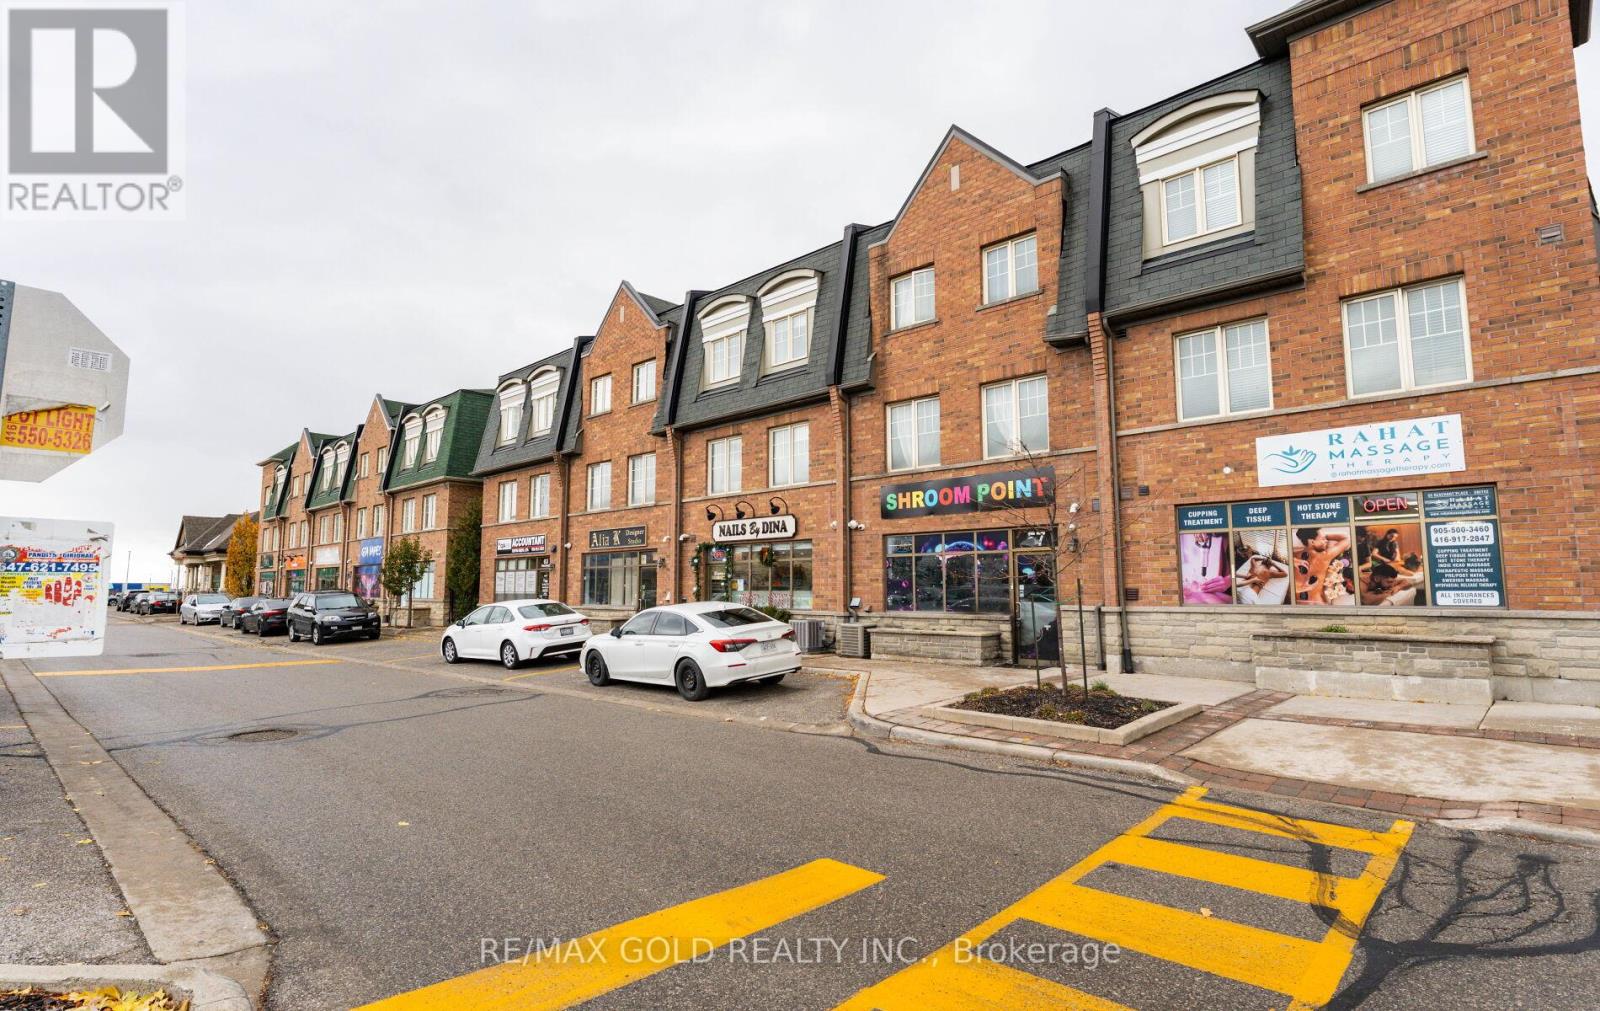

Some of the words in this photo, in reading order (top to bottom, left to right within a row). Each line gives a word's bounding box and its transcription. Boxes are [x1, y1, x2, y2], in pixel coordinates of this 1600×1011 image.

[46, 409, 95, 431] LIGHT
[17, 425, 91, 451] 550-5326
[1328, 420, 1449, 445] RAHAT
[1329, 438, 1449, 460] MASSAGE
[1330, 453, 1450, 469] THERAPY
[886, 485, 970, 511] SHROOM
[976, 477, 1049, 502] POINT
[1248, 507, 1268, 515] DEEP
[1297, 504, 1313, 512] HOT
[1314, 502, 1341, 510] STONE
[1362, 497, 1408, 513] OPEN
[1188, 510, 1218, 518] CUPPING
[1245, 515, 1272, 523] TISSUE
[1301, 511, 1338, 520] THERAPY
[719, 524, 747, 537] NAILS
[749, 522, 761, 537] By
[762, 520, 788, 534] DINA
[1183, 518, 1223, 526] TREATMENT
[1433, 526, 1490, 534] 905-500-3460
[512, 536, 545, 547] ACCOUNTANT
[591, 532, 610, 547] Alia
[1434, 535, 1490, 543] 416-917-2847
